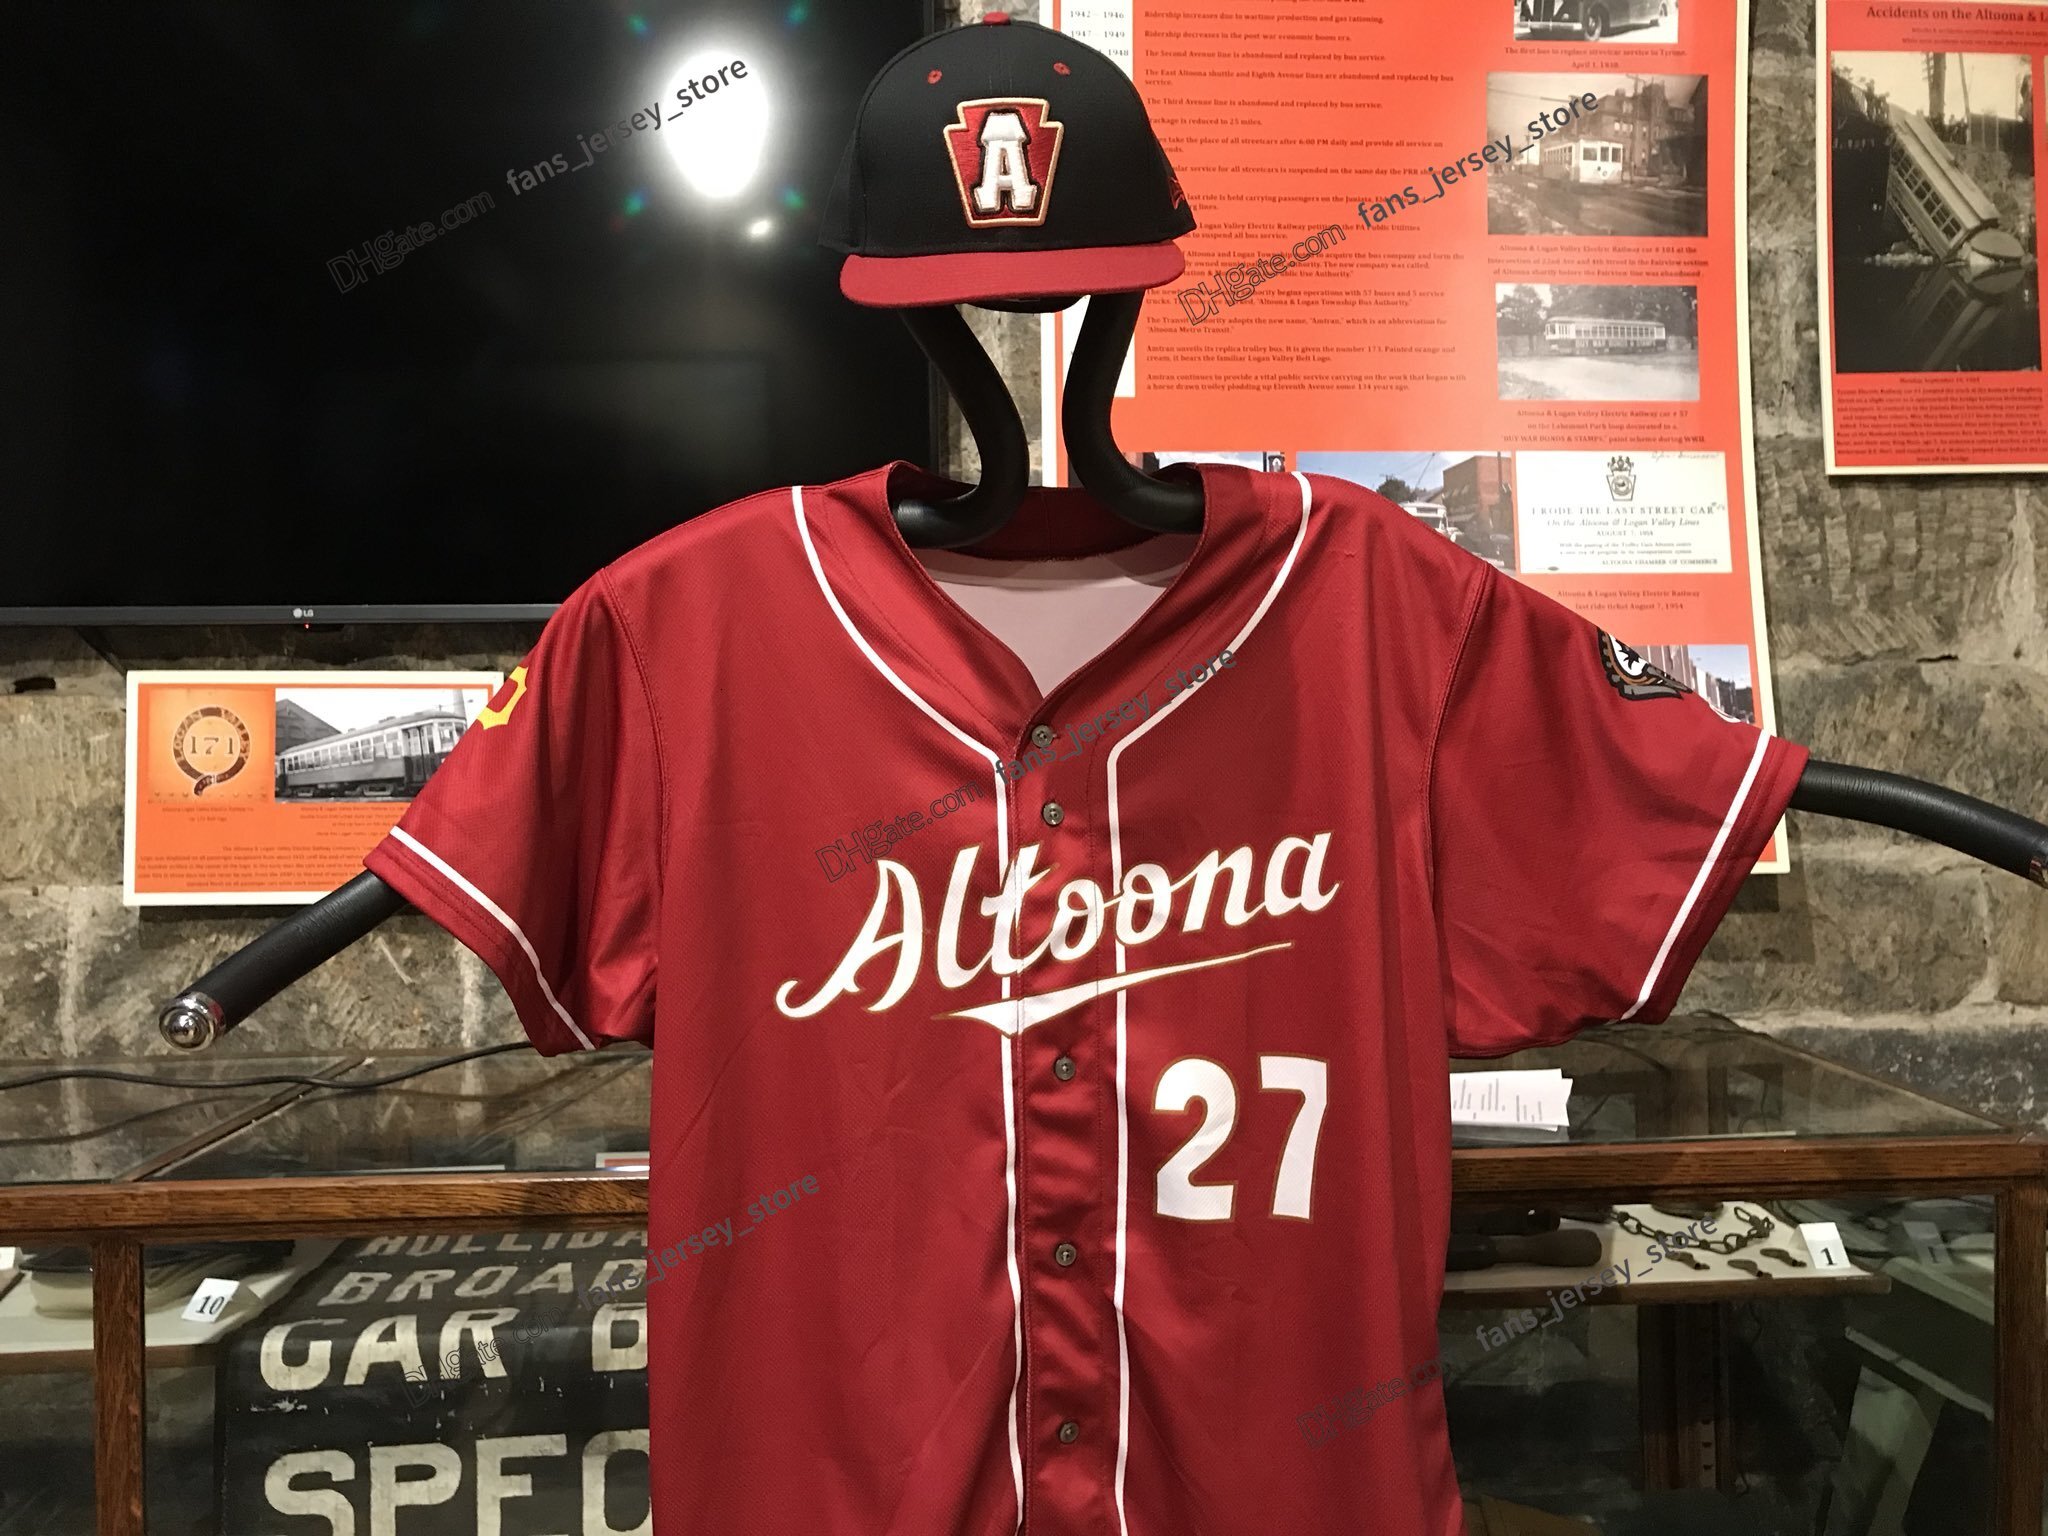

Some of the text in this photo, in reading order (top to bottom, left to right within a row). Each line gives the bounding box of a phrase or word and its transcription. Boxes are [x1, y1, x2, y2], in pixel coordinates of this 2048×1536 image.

[1866, 7, 1928, 19] Accidents
[1932, 11, 1948, 19] on
[1951, 9, 1971, 20] the
[1976, 10, 2023, 21] Altoona
[2026, 11, 2036, 22] &
[973, 109, 1040, 213] A
[1532, 506, 1714, 514] I RODE THE LAST STREET CAR
[775, 829, 1343, 1019] Altoona
[1151, 1053, 1330, 1224] 27
[1820, 1248, 1836, 1266] 1
[195, 1296, 225, 1315] 10
